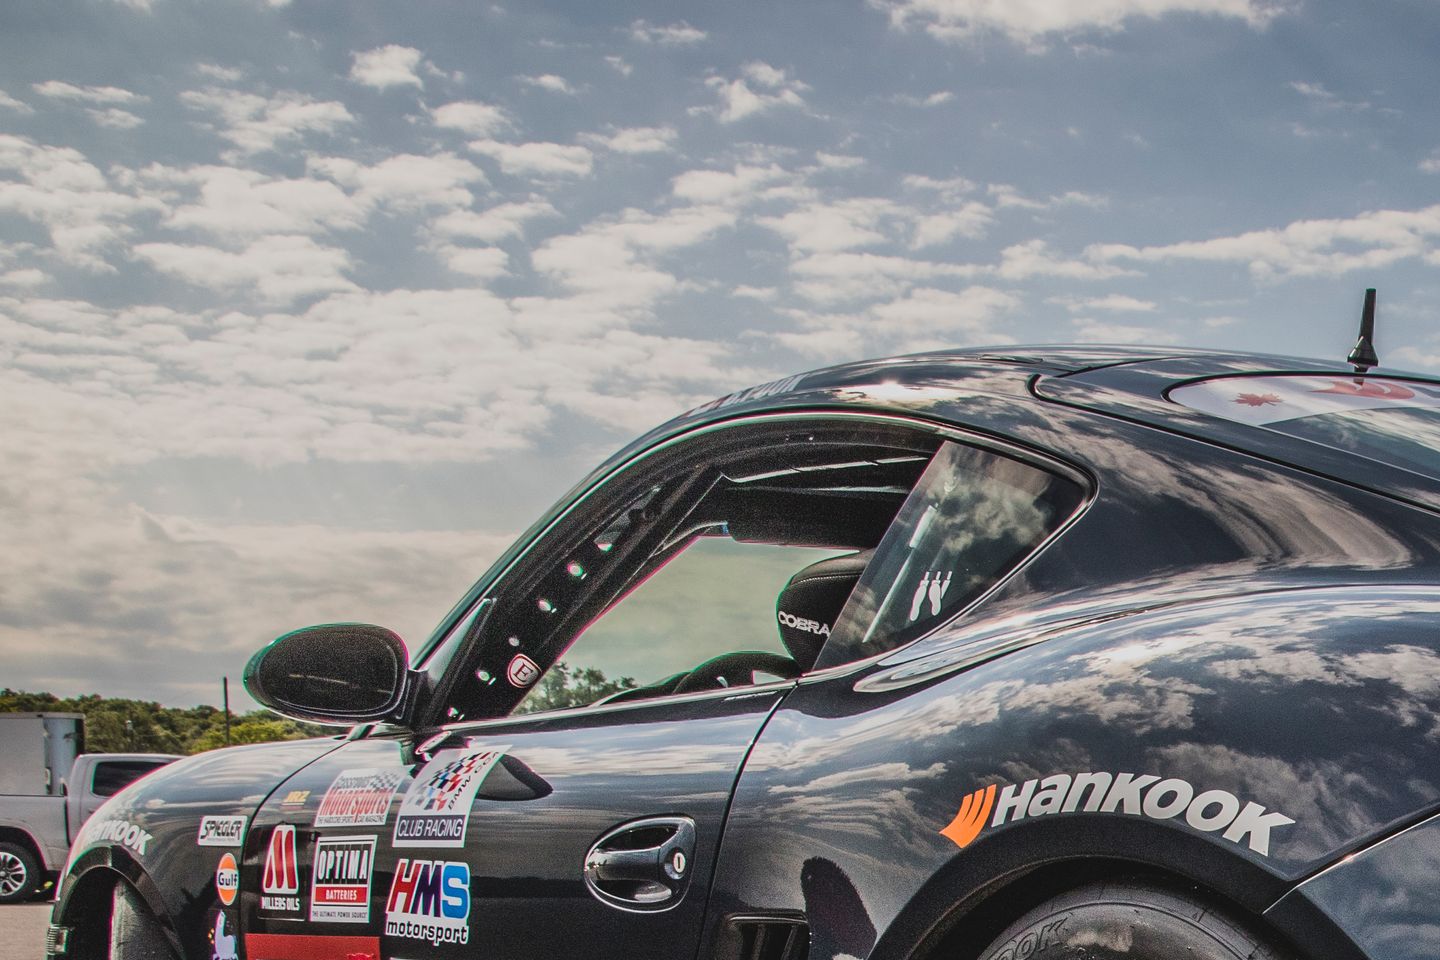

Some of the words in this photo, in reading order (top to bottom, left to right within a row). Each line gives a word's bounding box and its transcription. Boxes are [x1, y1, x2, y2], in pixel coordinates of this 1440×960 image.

[778, 610, 831, 638] COBRA
[200, 820, 243, 841] SPIEGLER
[397, 819, 424, 837] CLUB
[424, 819, 463, 837] RACING
[318, 850, 369, 880] OPTIMA
[218, 872, 238, 887] Gulf
[325, 890, 358, 901] BATTERIES
[387, 862, 469, 920] HMS
[261, 896, 286, 910] MILLERS
[286, 897, 301, 911] OILS
[386, 920, 467, 944] motorsport
